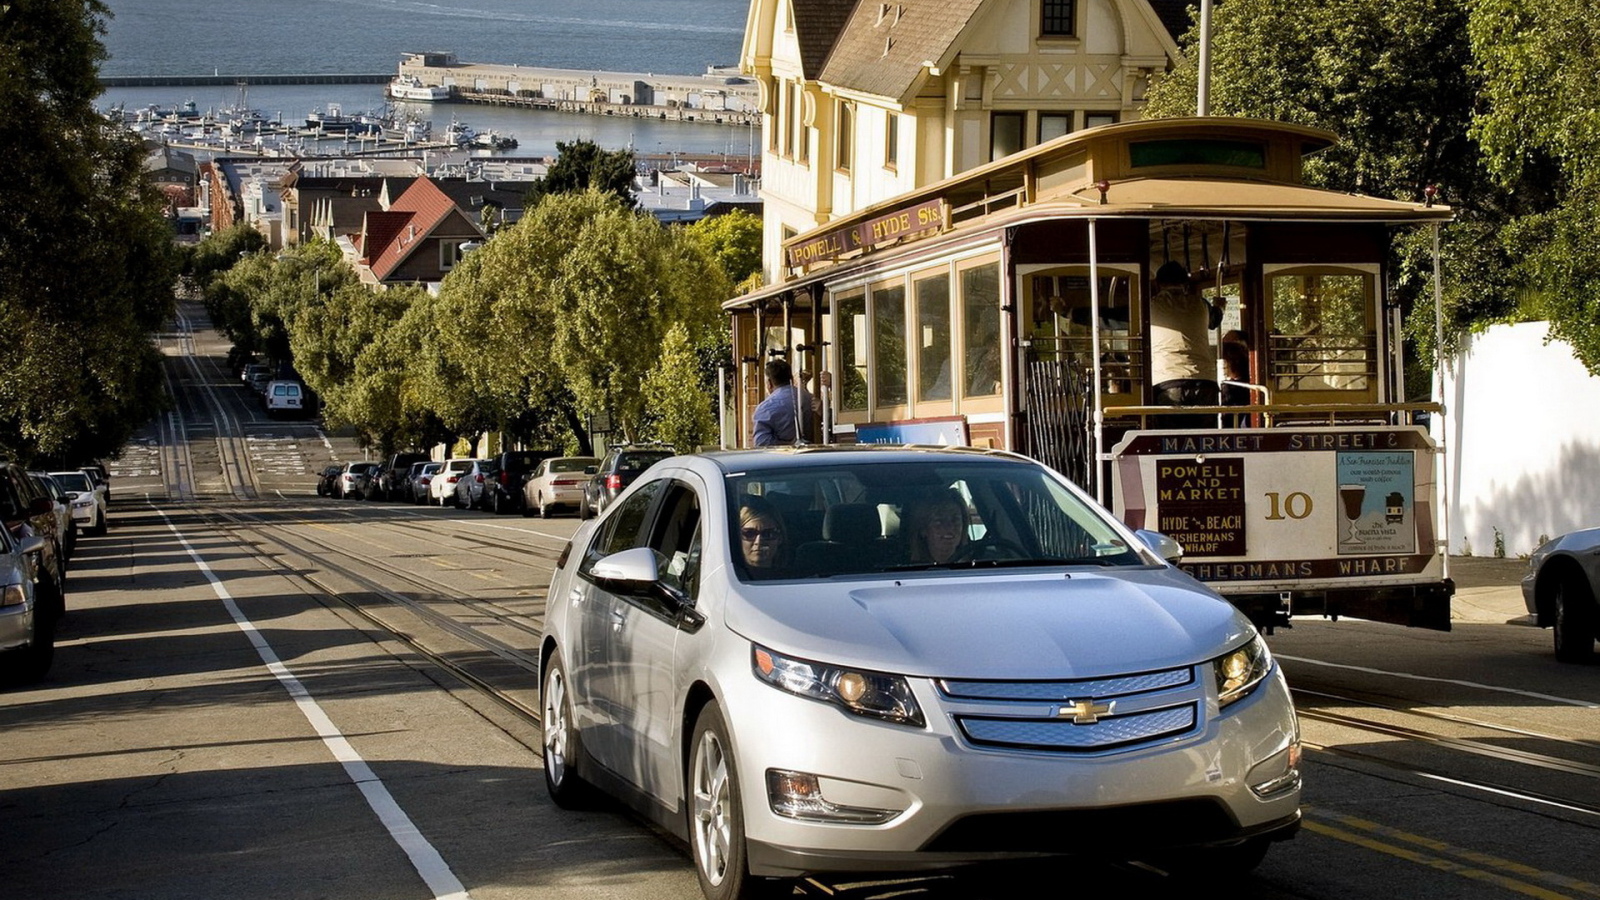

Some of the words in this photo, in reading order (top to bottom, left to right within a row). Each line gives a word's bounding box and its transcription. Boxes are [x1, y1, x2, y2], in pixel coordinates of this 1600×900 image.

[794, 236, 841, 262] POWELL
[851, 230, 862, 246] &
[872, 212, 910, 239] HYDE
[917, 206, 941, 226] Sts.
[1163, 436, 1263, 451] MARKET
[1291, 433, 1377, 448] STREET
[1162, 466, 1238, 478] POWELL
[1183, 479, 1220, 488] AND
[1161, 488, 1240, 500] MARKET
[1264, 491, 1313, 520] 10
[1162, 517, 1189, 530] HYDE
[1206, 515, 1242, 530] BEACH
[1169, 532, 1235, 543] FISHERMANS
[1185, 543, 1218, 552] WHARF
[1182, 562, 1312, 578] SHERMANS
[1340, 557, 1409, 573] WHARF
